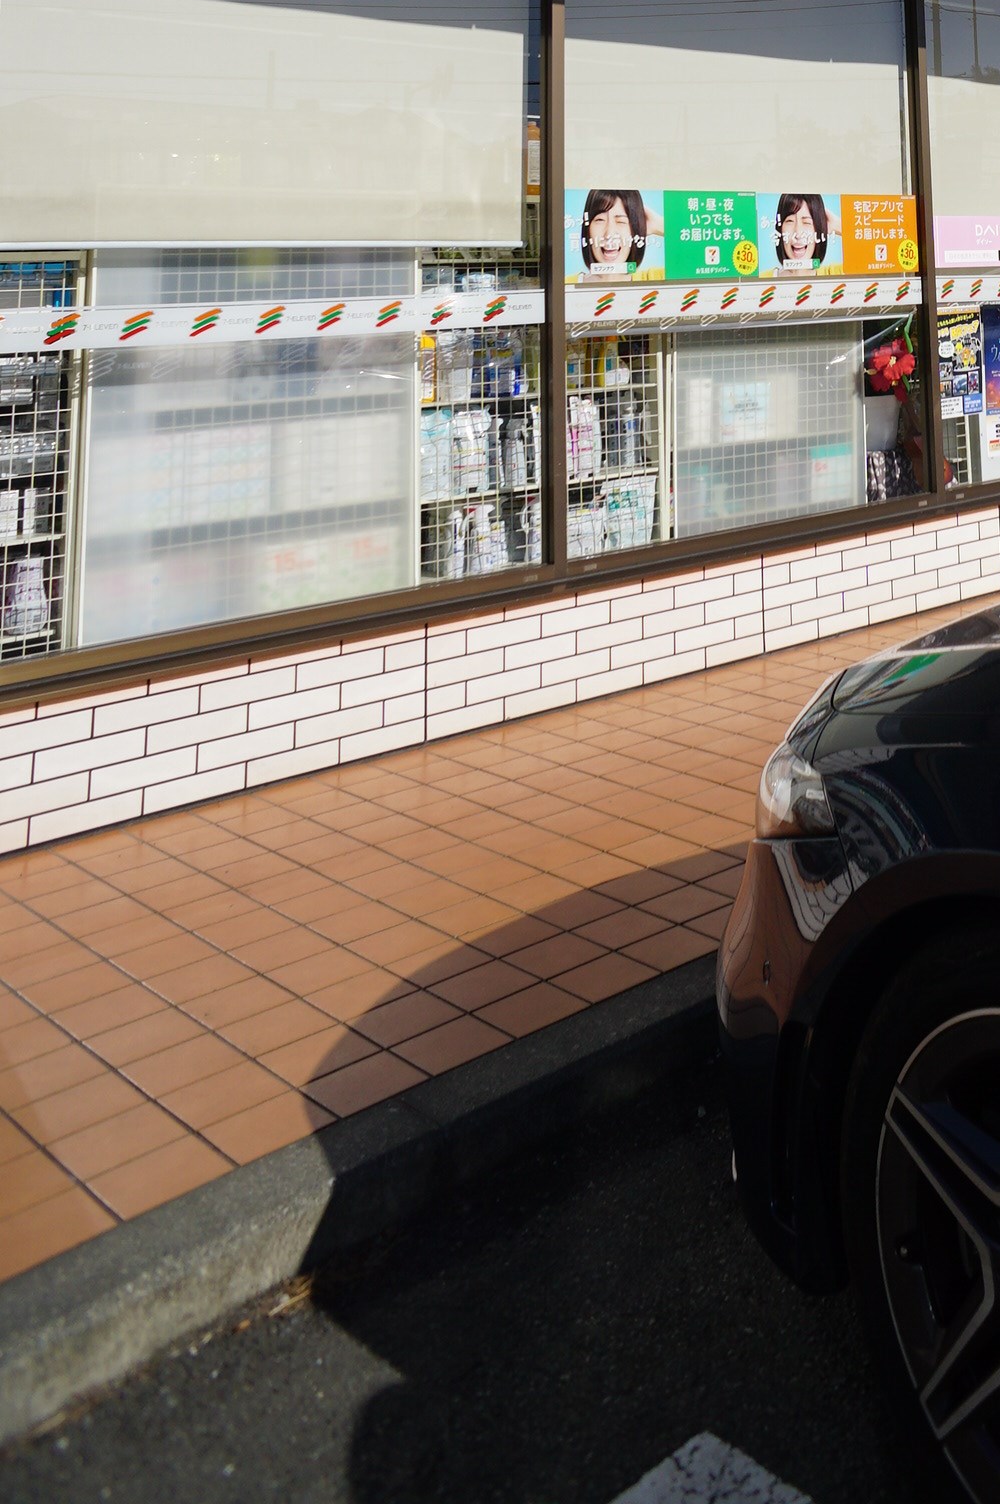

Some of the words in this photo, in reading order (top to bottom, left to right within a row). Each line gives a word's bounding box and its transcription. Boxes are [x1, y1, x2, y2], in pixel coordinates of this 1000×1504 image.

[853, 200, 904, 213] 宅配アプリで
[690, 213, 733, 225] いつでも
[680, 228, 745, 241] お届けします。
[854, 228, 908, 241] お届けします。
